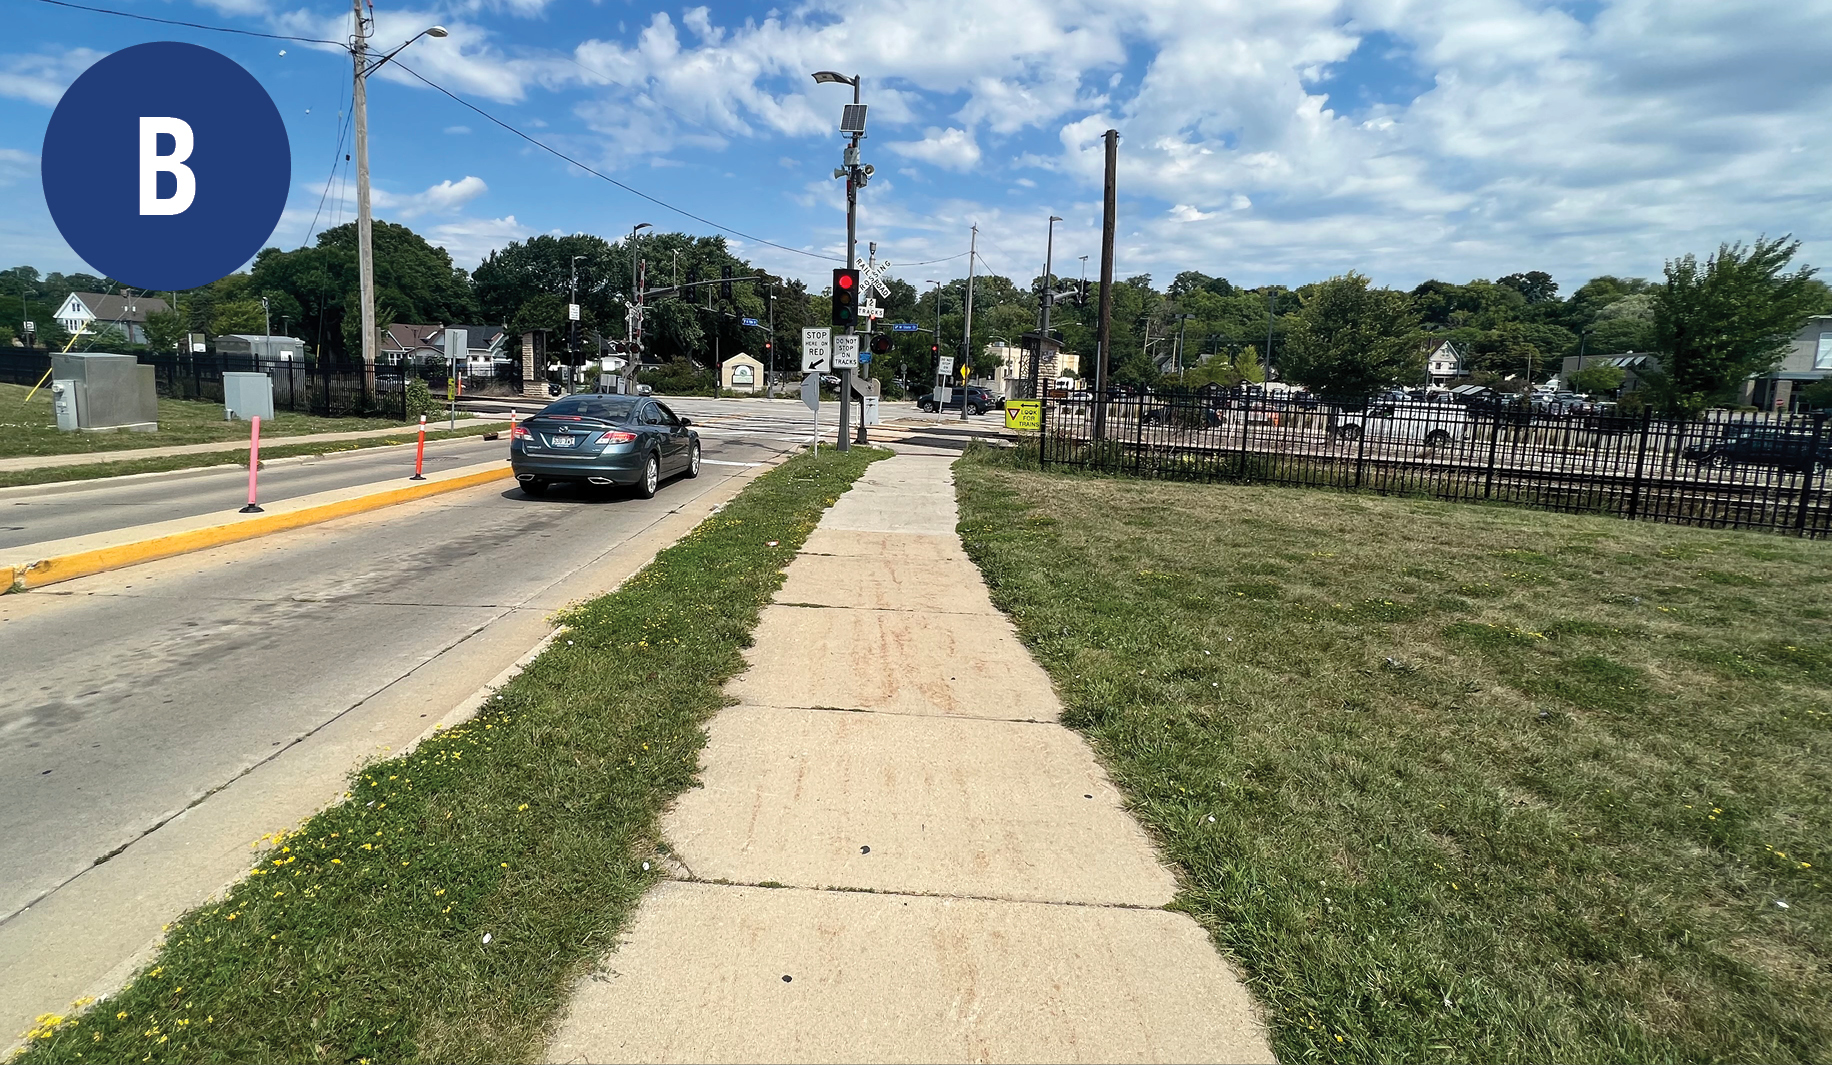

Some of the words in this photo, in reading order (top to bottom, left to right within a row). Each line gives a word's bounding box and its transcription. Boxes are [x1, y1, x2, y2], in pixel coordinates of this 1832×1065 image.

[858, 260, 891, 294] ROSSING
[858, 308, 883, 316] TRACKS
[806, 331, 827, 339] STOP
[809, 348, 825, 356] RED
